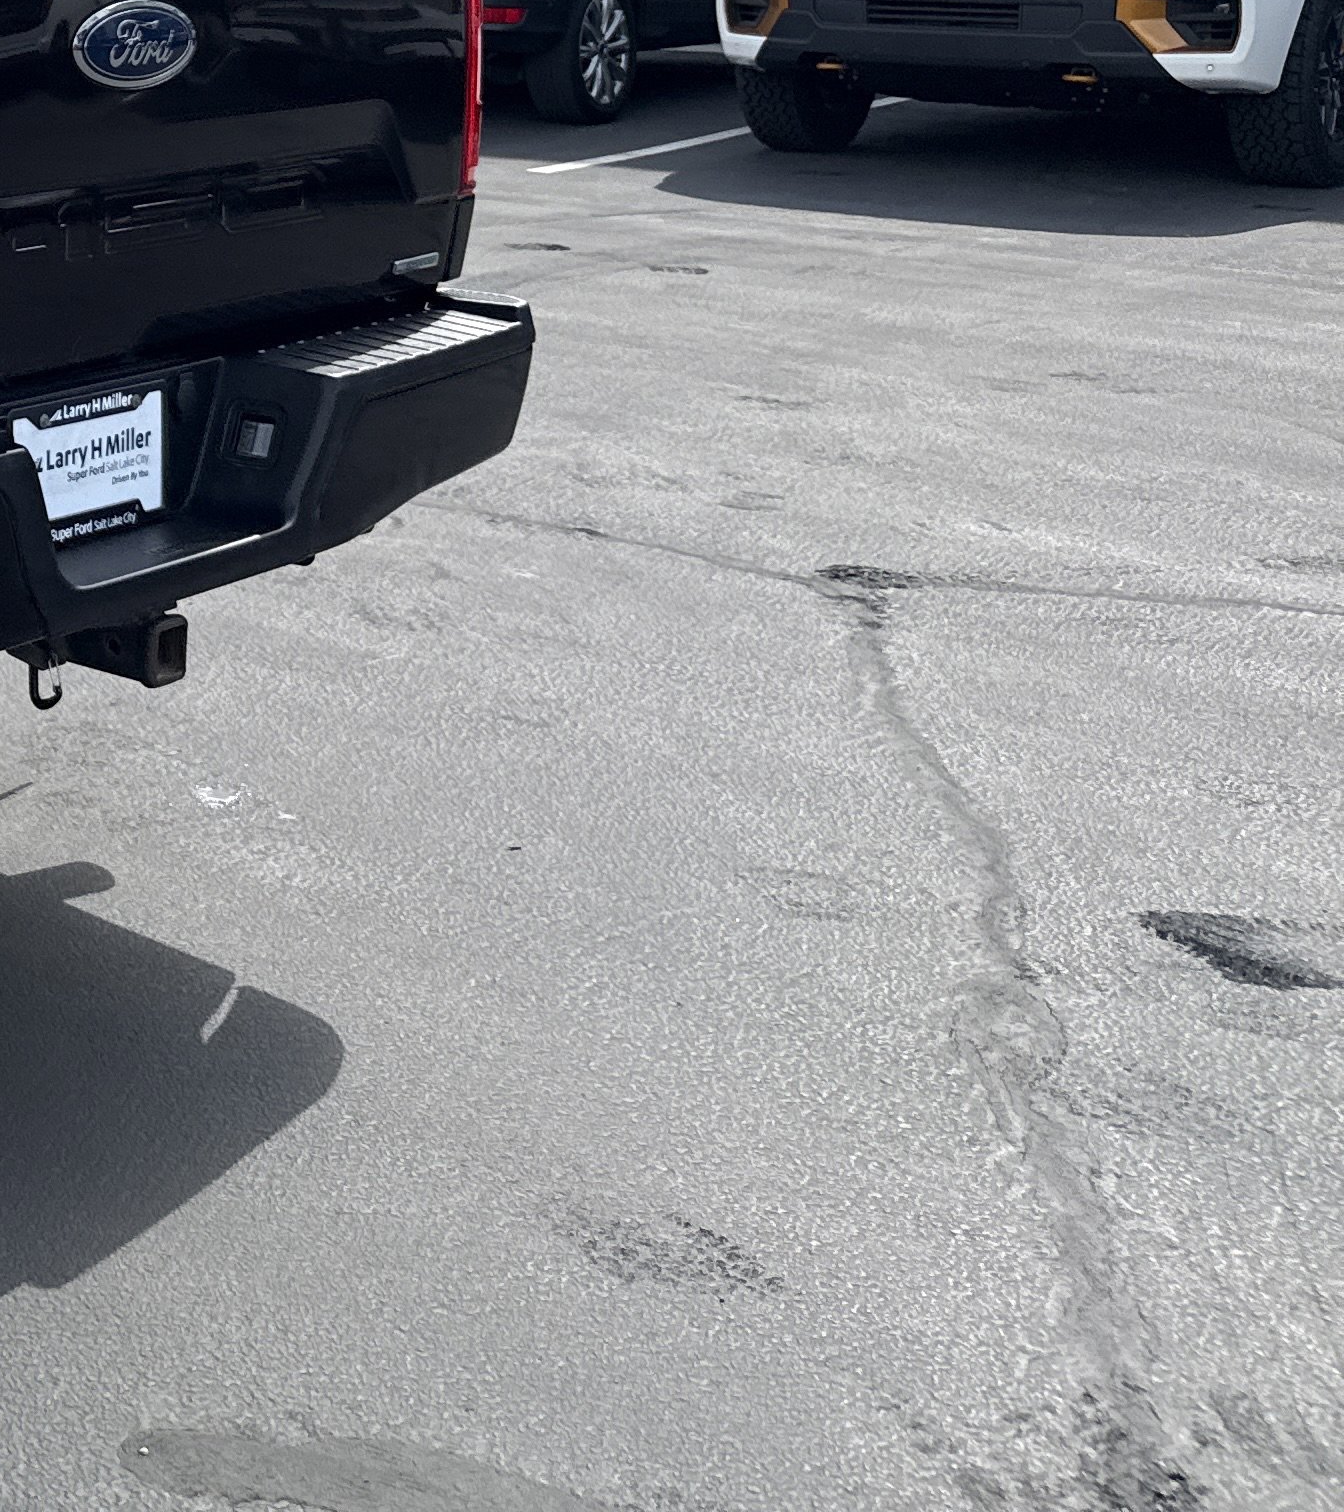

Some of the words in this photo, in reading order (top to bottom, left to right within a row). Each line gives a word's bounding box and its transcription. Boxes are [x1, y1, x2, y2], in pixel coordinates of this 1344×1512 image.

[109, 18, 176, 69] Ford
[63, 402, 91, 420] Larry
[91, 398, 101, 413] H
[102, 392, 133, 409] Miller
[46, 445, 88, 471] Larry
[91, 437, 102, 460] H
[105, 426, 152, 457] Miller
[67, 468, 88, 482] Super
[89, 463, 105, 477] Ford
[106, 460, 118, 473] Salt
[119, 456, 135, 469] Lake
[135, 454, 150, 467] City
[112, 474, 130, 485] Driven
[130, 472, 138, 481] By
[138, 470, 149, 478] You
[50, 527, 73, 542] Super
[74, 521, 93, 537] Ford
[93, 519, 107, 531] Salt
[107, 515, 123, 528] Lake
[123, 511, 137, 525] City
